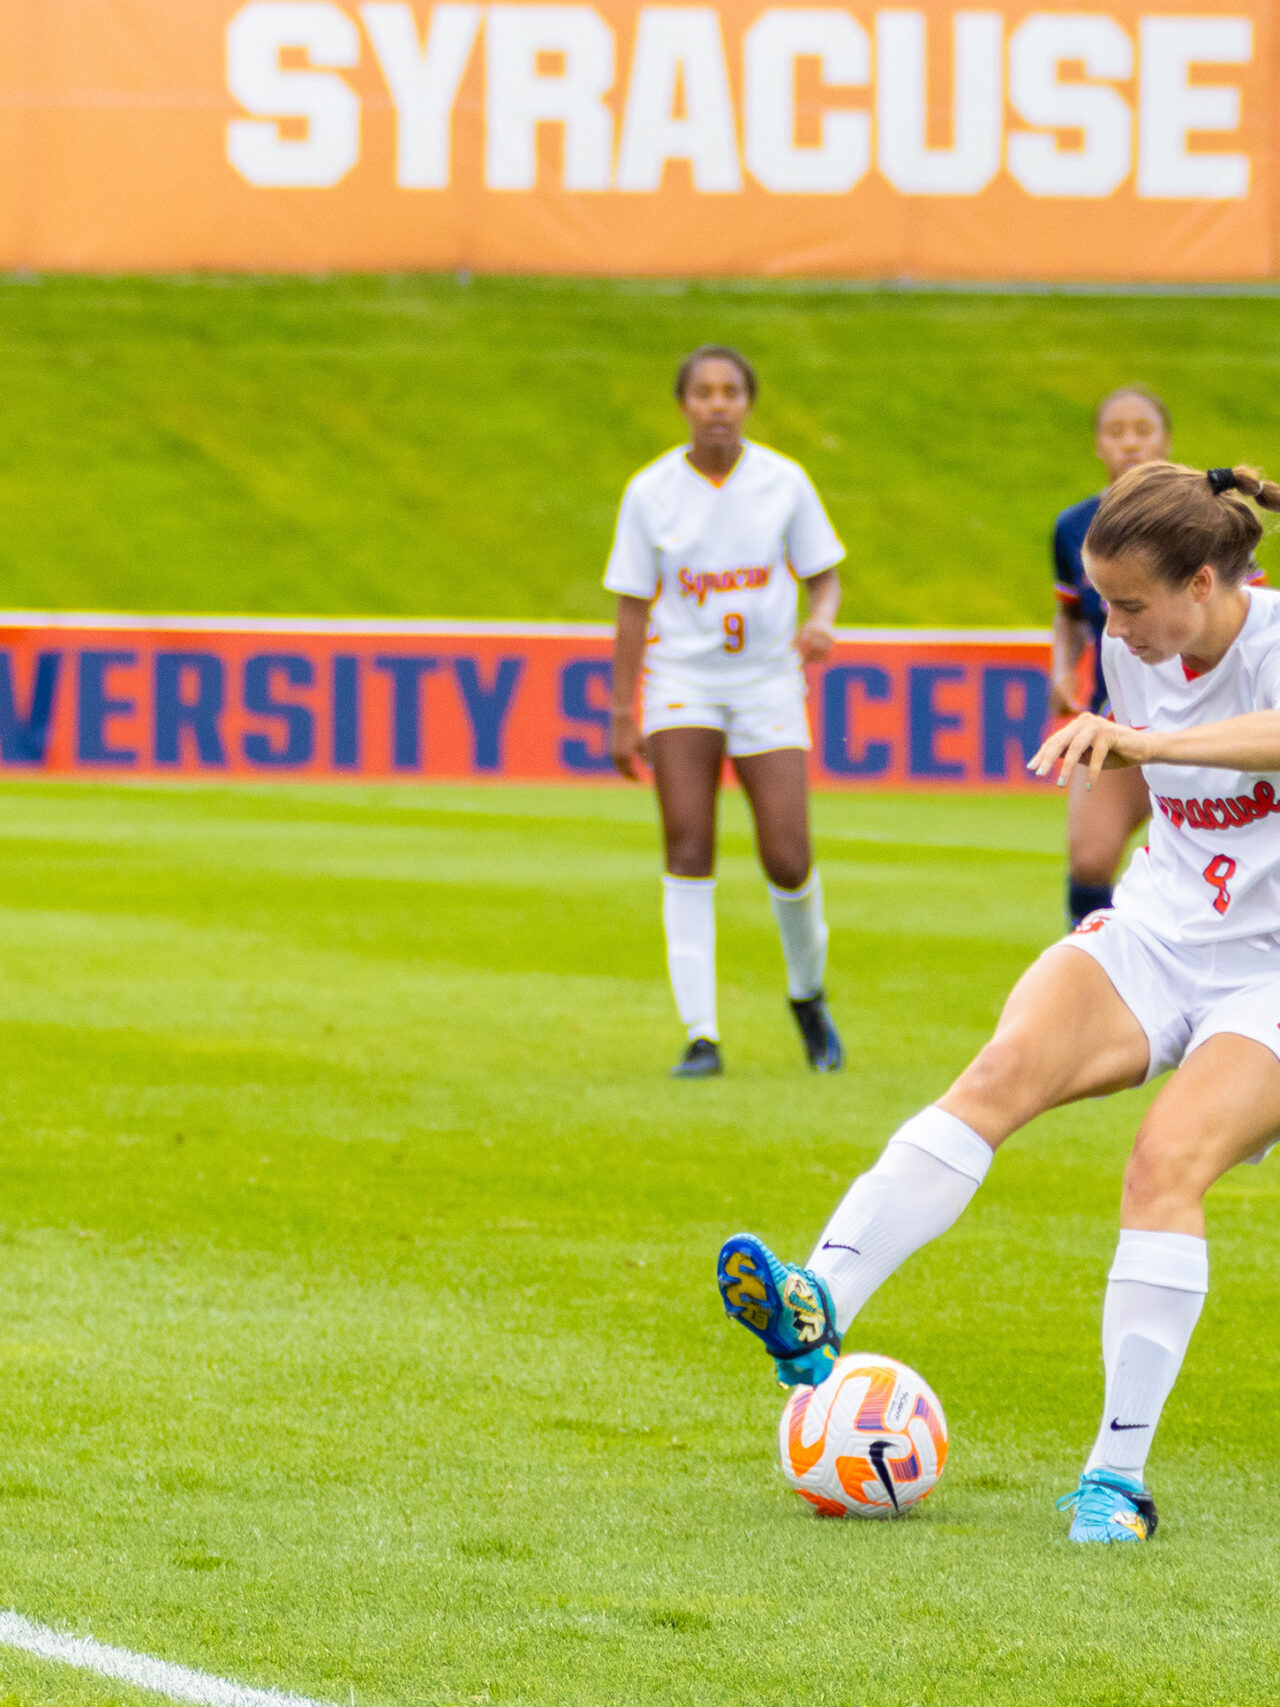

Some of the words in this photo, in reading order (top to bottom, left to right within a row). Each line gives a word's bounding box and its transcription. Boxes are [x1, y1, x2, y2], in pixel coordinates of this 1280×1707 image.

[225, 2, 1254, 200] SYRACUSE
[677, 564, 773, 608] Syracu
[722, 611, 745, 654] 9
[0, 648, 526, 774] VERSITY
[557, 659, 1060, 782] SCER
